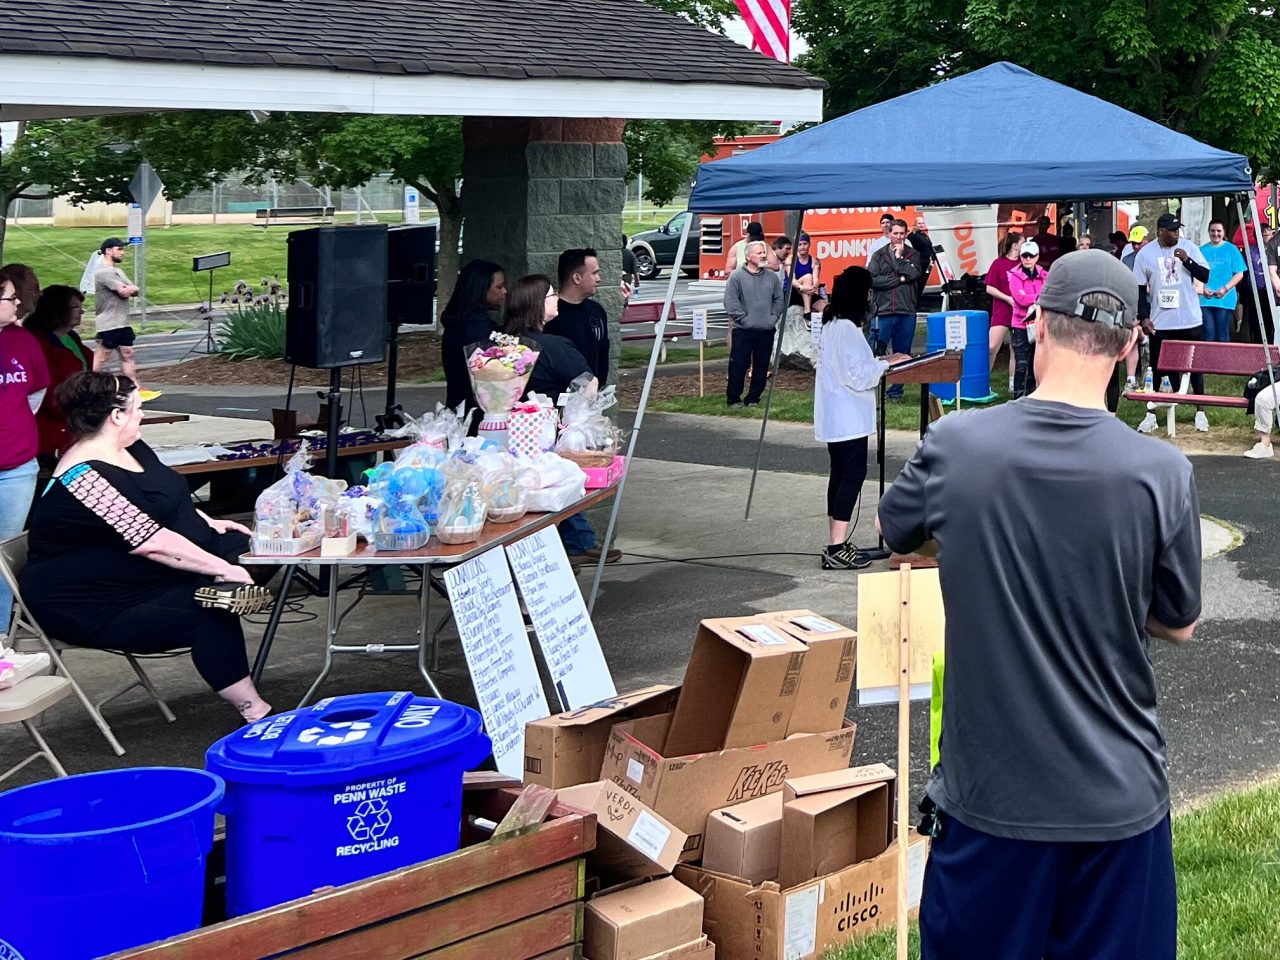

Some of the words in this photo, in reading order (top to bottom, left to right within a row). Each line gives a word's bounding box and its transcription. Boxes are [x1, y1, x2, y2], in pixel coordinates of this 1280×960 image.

[817, 237, 876, 260] DUNKI
[333, 789, 366, 805] PENN
[368, 782, 407, 800] WASTE
[345, 780, 386, 792] PROPERTY
[386, 777, 397, 786] OF
[605, 789, 637, 816] VERDE
[336, 836, 400, 857] RECYCLING
[837, 904, 879, 932] CISCO
